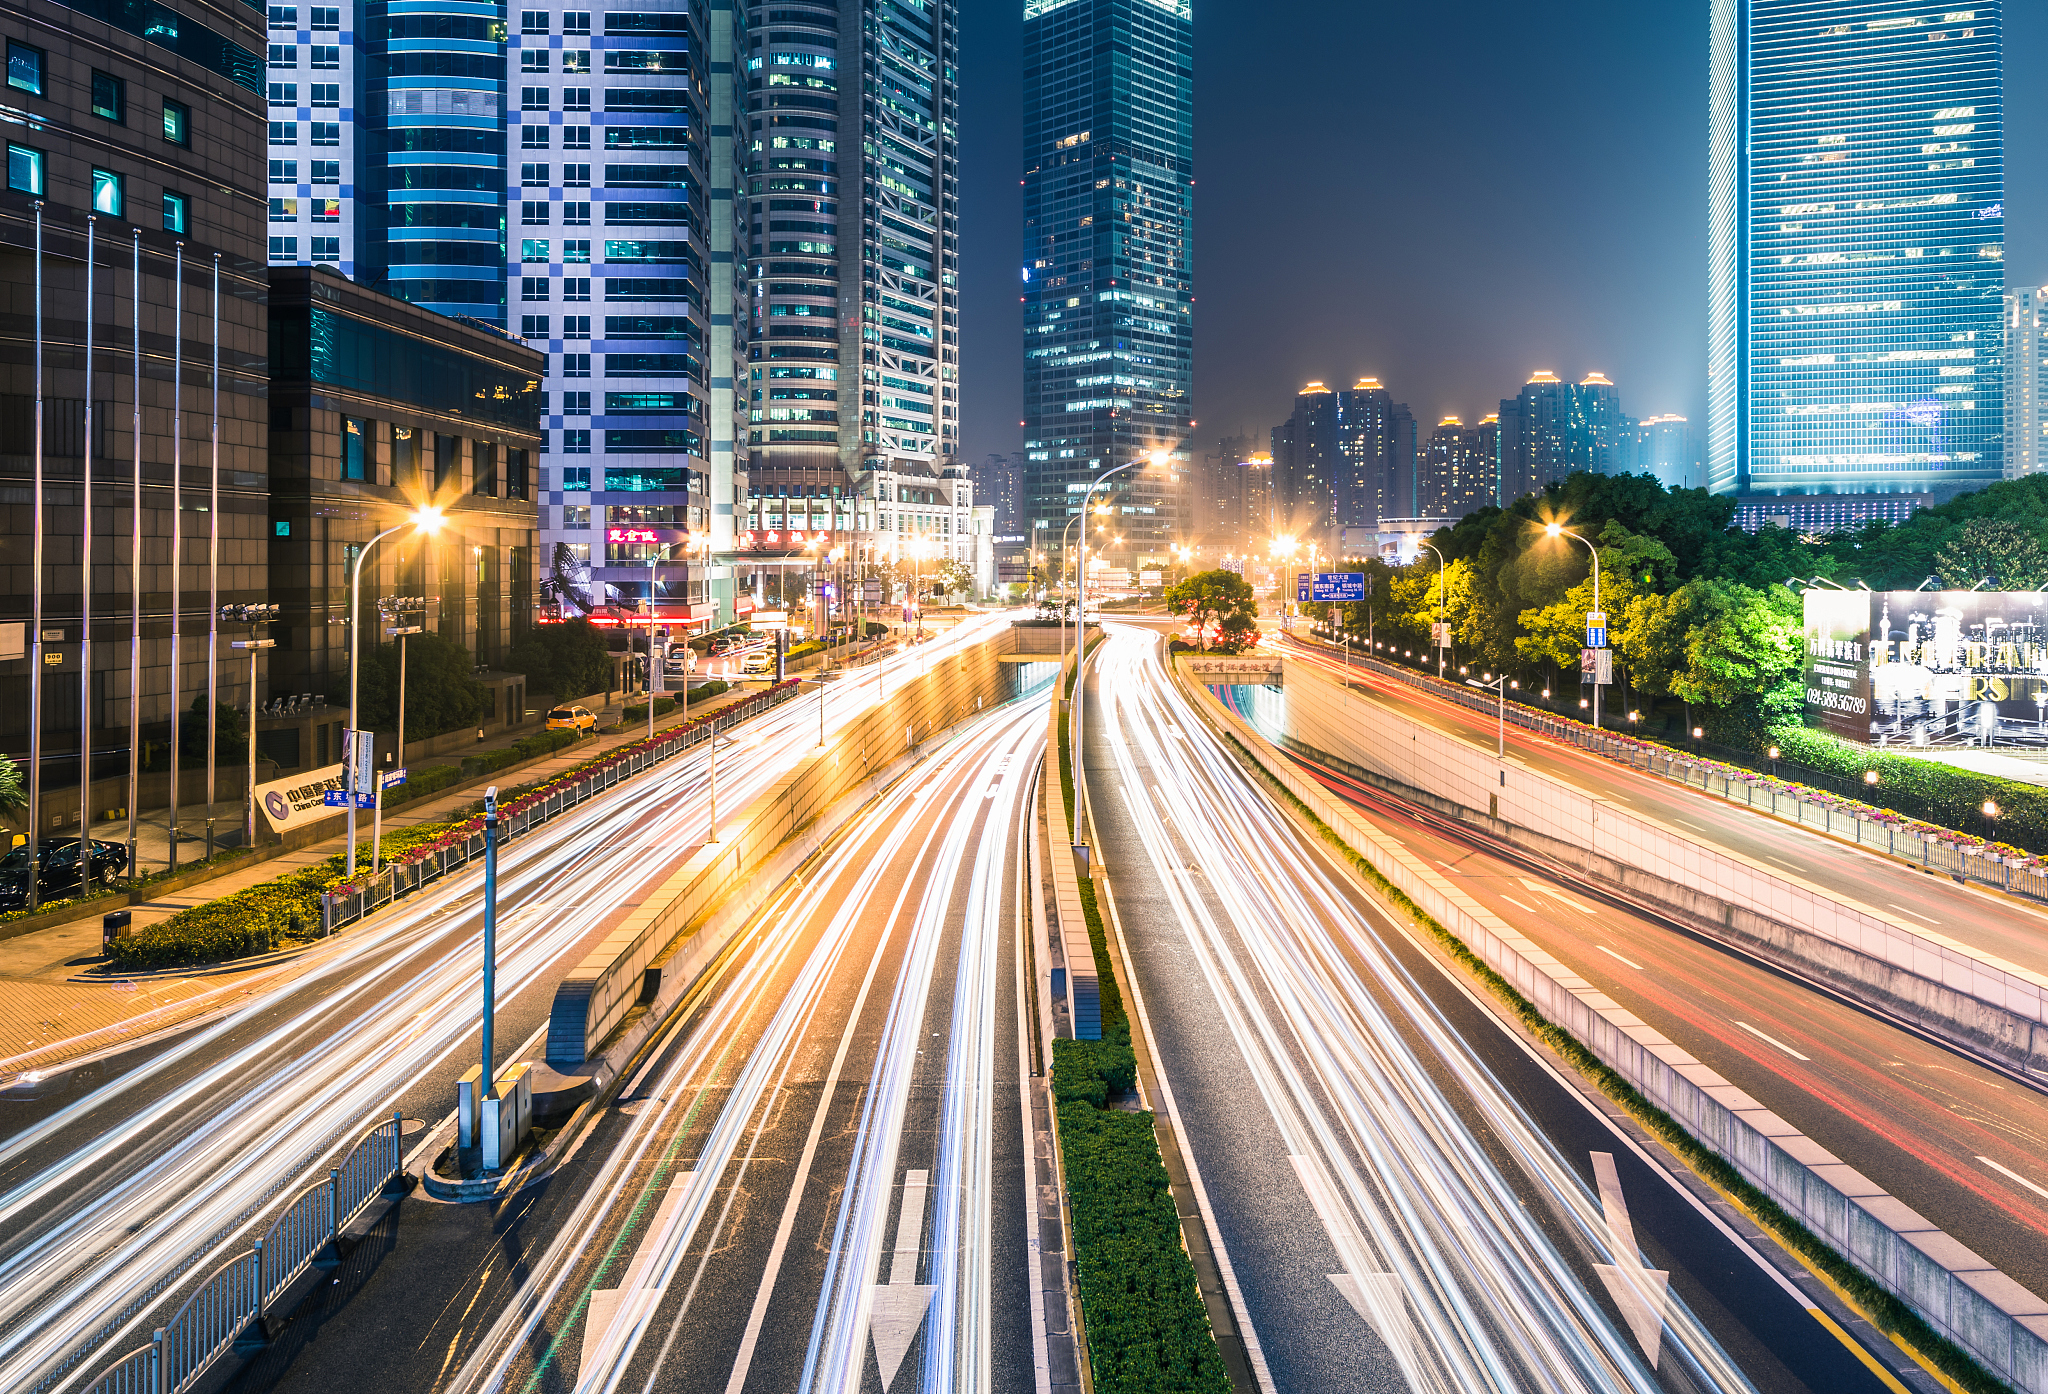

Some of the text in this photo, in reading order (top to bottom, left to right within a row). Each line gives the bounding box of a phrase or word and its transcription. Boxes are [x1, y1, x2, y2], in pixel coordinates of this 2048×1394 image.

[1807, 688, 1866, 714] 021-588 56789
[293, 803, 311, 812] China
